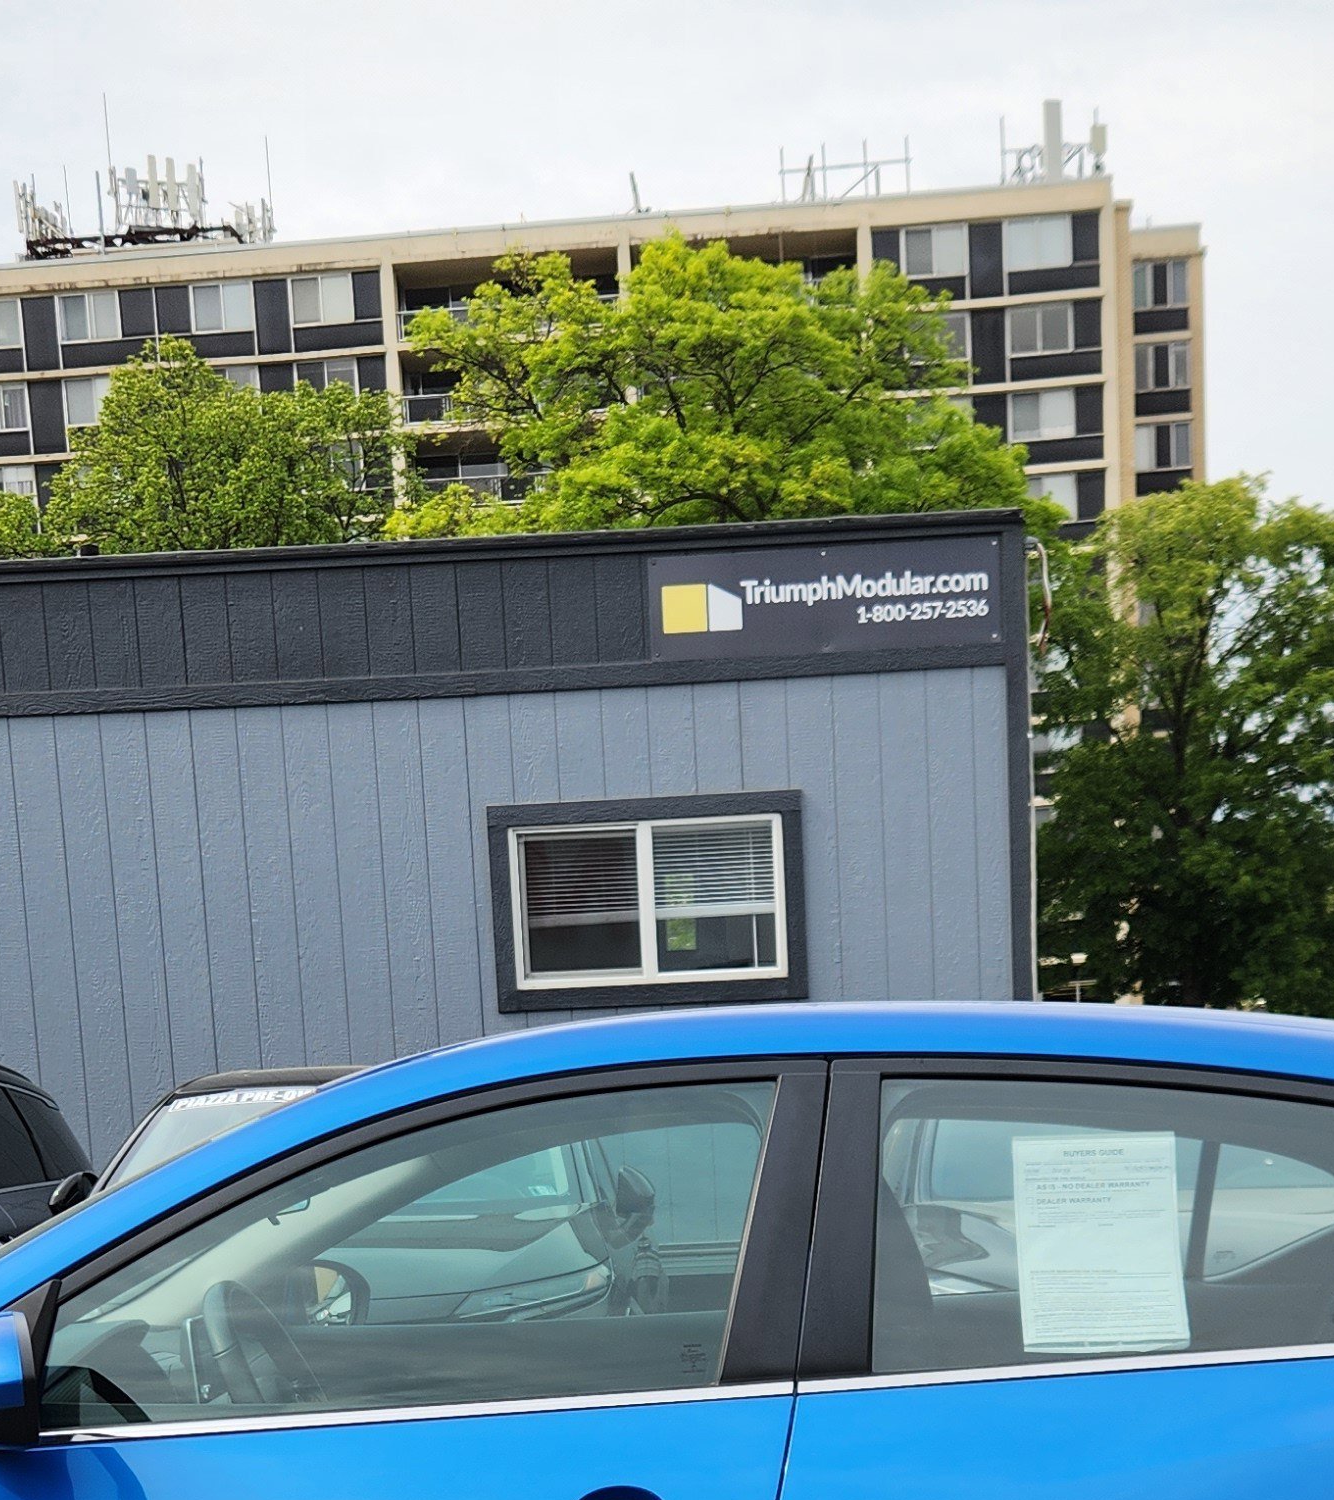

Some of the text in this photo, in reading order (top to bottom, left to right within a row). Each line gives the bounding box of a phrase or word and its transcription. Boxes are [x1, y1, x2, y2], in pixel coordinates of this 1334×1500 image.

[739, 571, 989, 606] TriumphModular.com
[857, 598, 989, 624] 1-800-257-2536
[175, 1092, 237, 1110] PIAZZA
